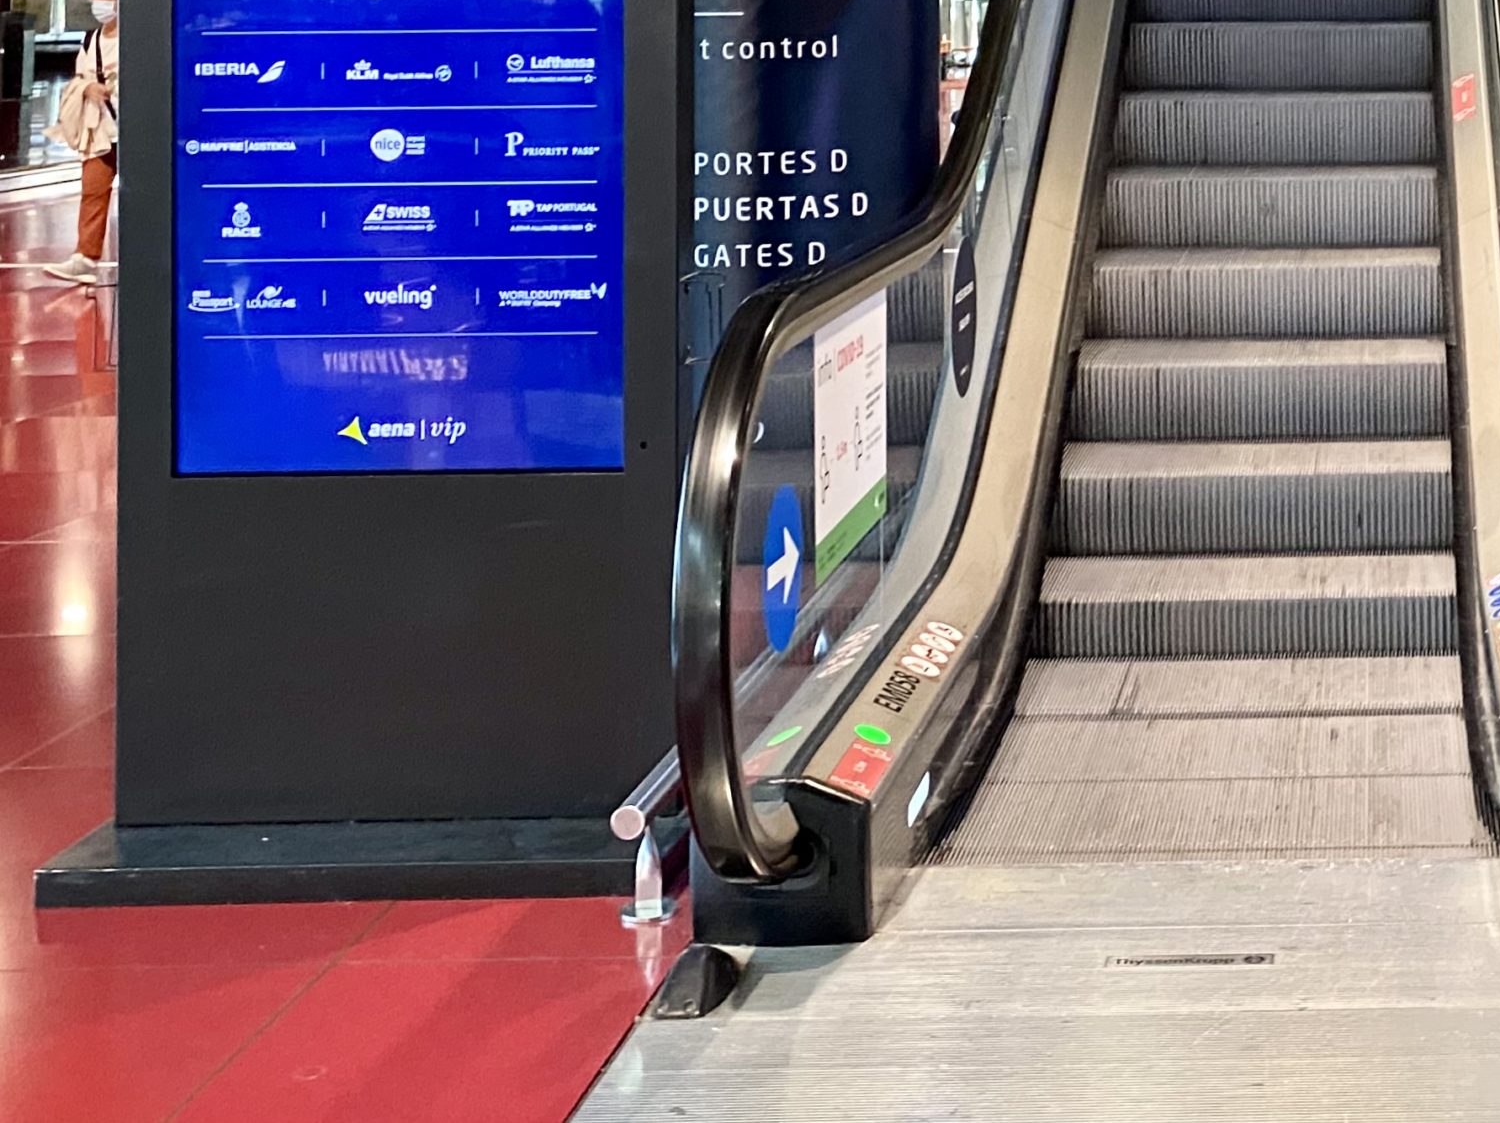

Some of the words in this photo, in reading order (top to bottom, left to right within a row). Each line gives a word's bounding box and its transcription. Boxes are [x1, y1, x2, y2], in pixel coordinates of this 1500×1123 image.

[722, 35, 837, 59] control
[195, 63, 259, 76] IBERIA
[530, 56, 594, 69] Lufthansa
[346, 69, 378, 80] KLM
[375, 137, 401, 151] nice
[523, 146, 568, 156] PRIORITY
[695, 151, 816, 175] PORTES
[831, 149, 847, 172] D
[386, 206, 430, 219] SWISS
[694, 194, 839, 221] PUERTAS
[852, 193, 868, 216] D
[695, 243, 793, 267] GATES
[808, 242, 825, 265] D
[364, 287, 431, 309] vueling
[368, 423, 415, 437] aena
[430, 417, 466, 444] vip
[874, 671, 920, 713] EM058
